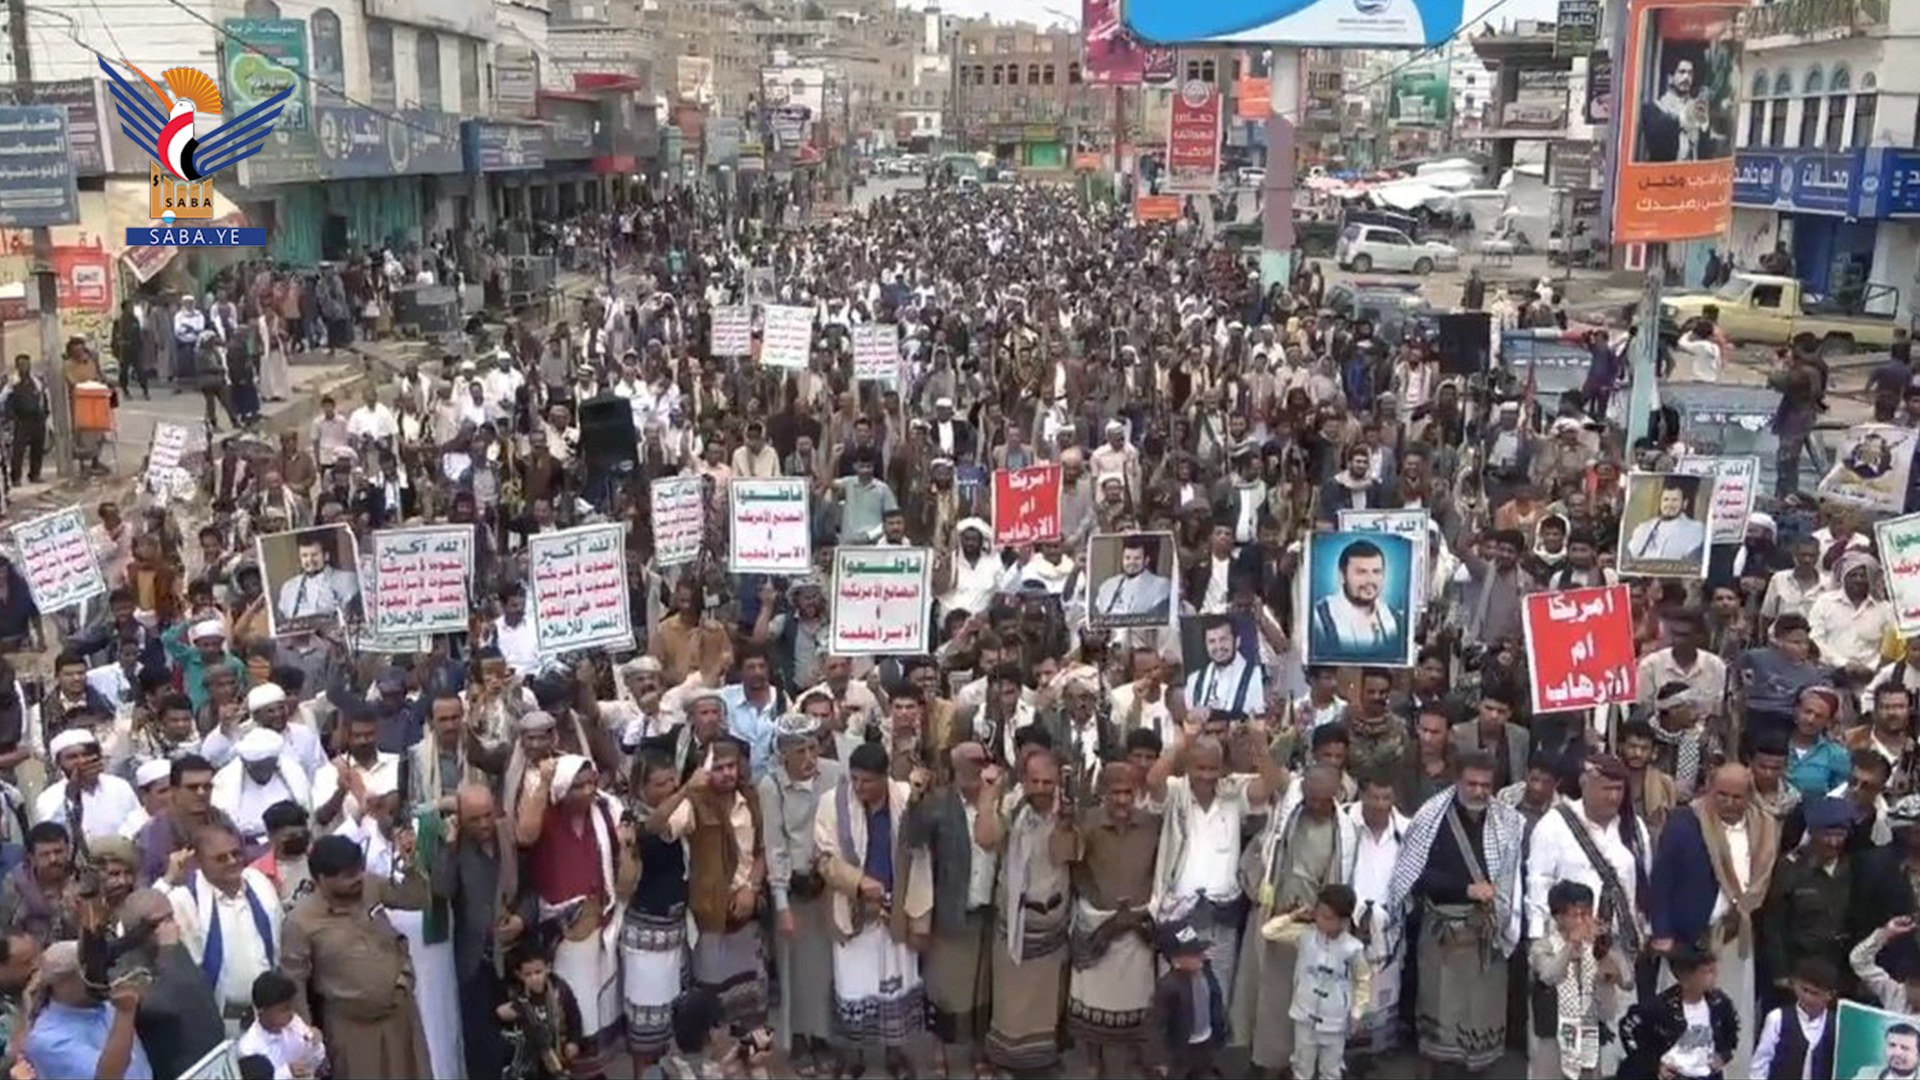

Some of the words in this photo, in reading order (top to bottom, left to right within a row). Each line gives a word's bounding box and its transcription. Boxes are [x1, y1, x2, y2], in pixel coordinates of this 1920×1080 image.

[1802, 162, 1849, 189] محلات
[736, 485, 803, 506] قاطعوا
[434, 539, 467, 552] الله
[588, 537, 618, 553] الله
[842, 557, 921, 578] قاطعوا
